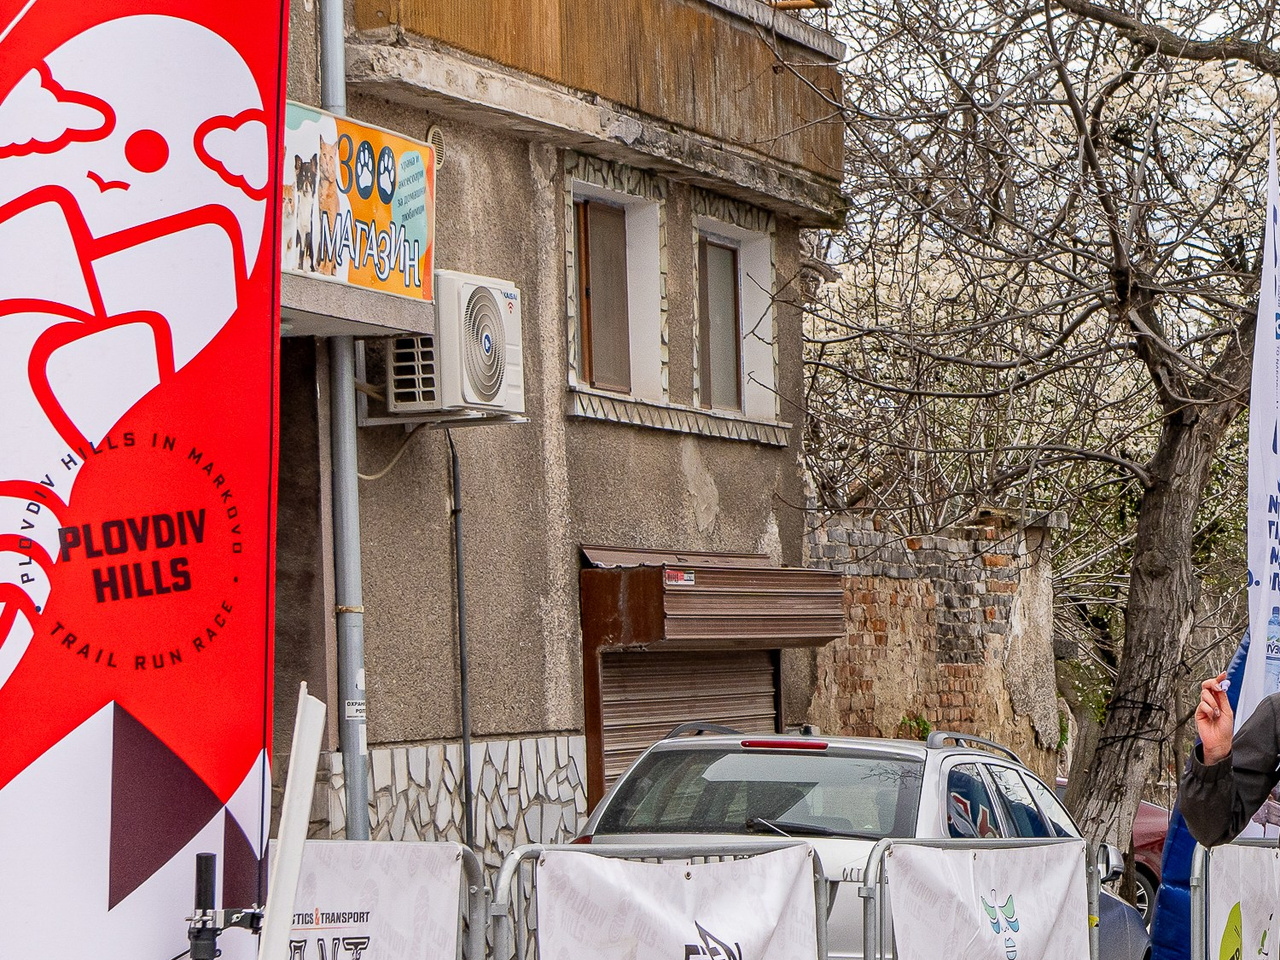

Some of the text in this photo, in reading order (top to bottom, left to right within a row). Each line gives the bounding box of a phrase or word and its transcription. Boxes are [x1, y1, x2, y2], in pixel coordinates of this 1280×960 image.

[320, 209, 421, 288] МАГАЗИН
[18, 432, 243, 584] PLOVDIV HILLS IN MARKOVO
[58, 508, 206, 562] PLOVDIV
[92, 556, 192, 603] HILLS
[50, 600, 233, 670] TRAIL RUN RACE
